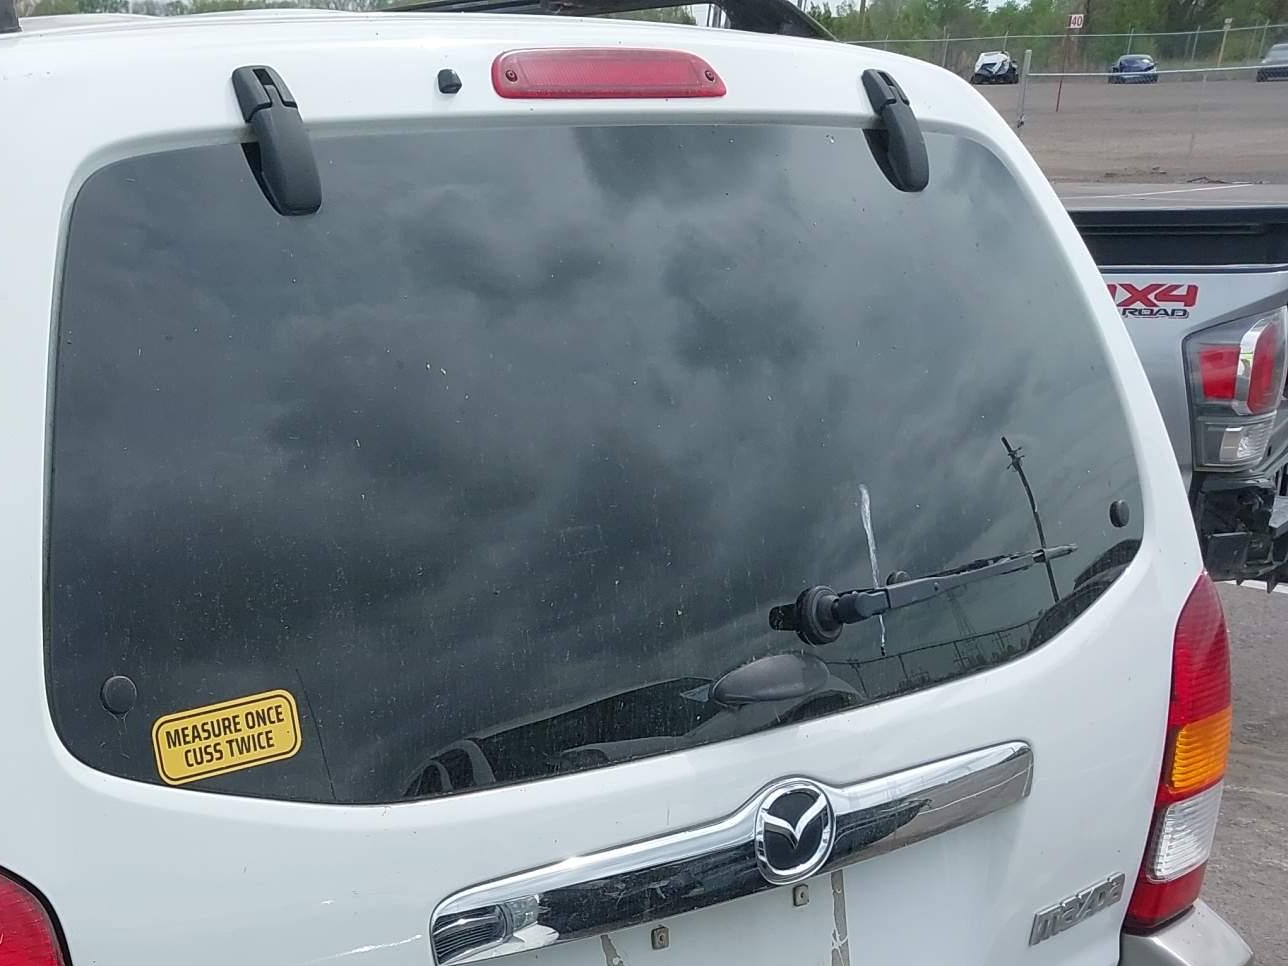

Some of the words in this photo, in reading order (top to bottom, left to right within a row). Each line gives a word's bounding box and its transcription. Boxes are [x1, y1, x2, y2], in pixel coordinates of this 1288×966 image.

[1122, 307, 1190, 319] ROAD
[165, 714, 242, 749] MEASURE
[244, 704, 285, 729] ONCE
[184, 744, 224, 768] CUSS
[225, 730, 275, 758] TWICE
